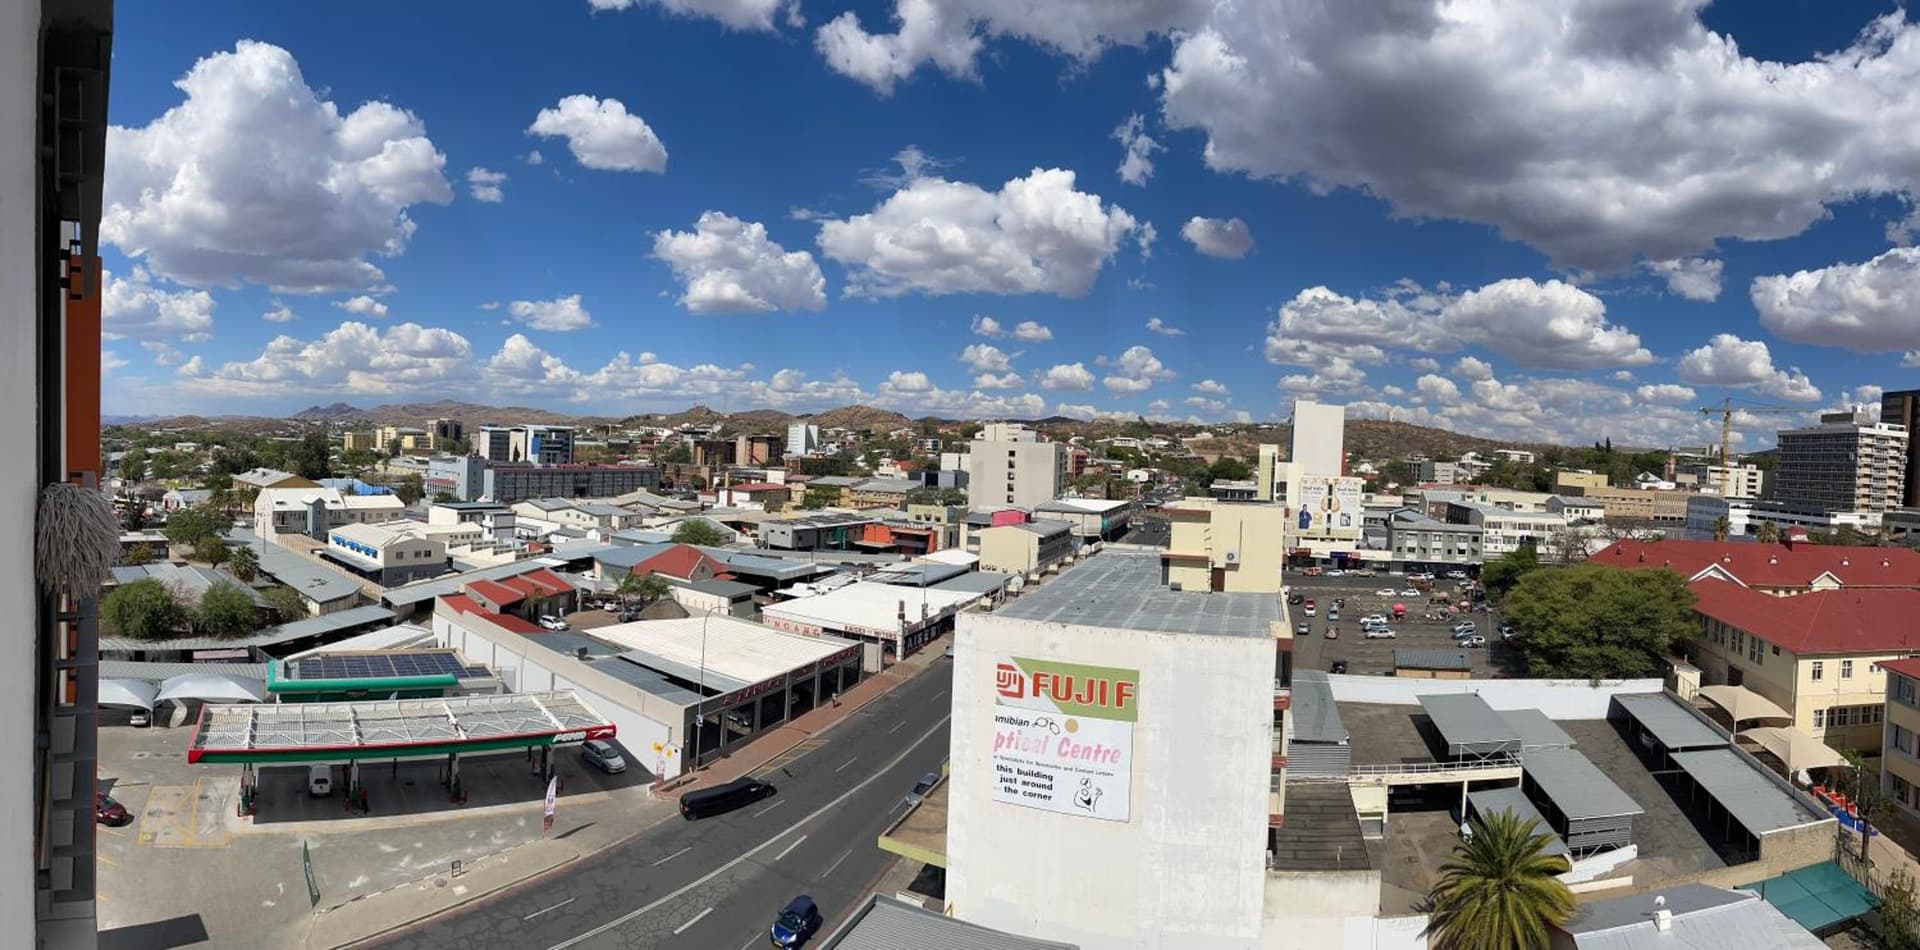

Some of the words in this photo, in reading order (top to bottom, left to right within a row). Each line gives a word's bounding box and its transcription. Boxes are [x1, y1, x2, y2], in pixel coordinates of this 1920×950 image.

[1057, 737, 1122, 764] Centre
[996, 763, 1014, 775] this
[1017, 768, 1054, 782] building
[999, 774, 1017, 785] just
[1021, 778, 1053, 791] around
[1004, 786, 1018, 795] the
[1022, 789, 1053, 801] corner
